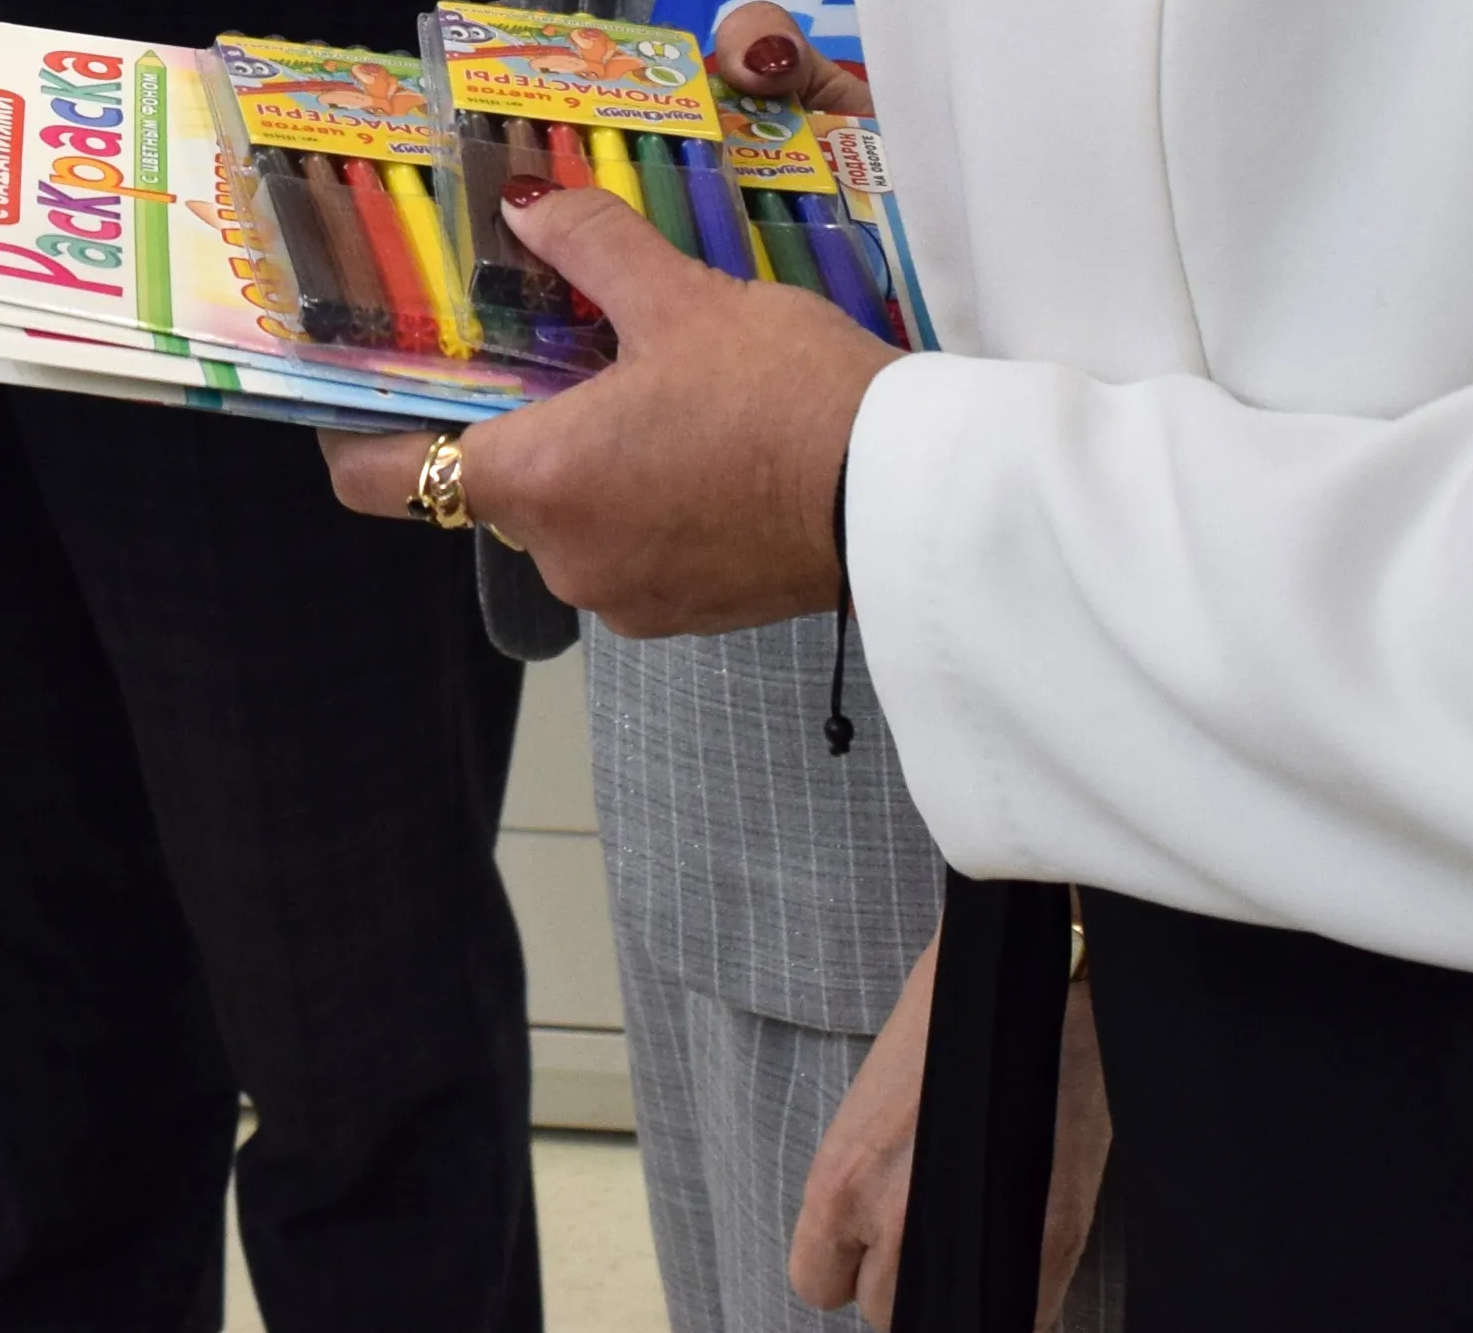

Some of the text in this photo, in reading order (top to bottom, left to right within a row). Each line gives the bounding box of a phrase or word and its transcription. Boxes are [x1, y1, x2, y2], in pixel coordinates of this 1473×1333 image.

[139, 72, 159, 114] ФОНОМ
[463, 67, 702, 111] ФЛОМАСТЕРЫ
[465, 83, 582, 110] 6 цветов
[254, 102, 430, 139] ОМАСТЕРЫ
[260, 119, 374, 145] 6 цветов
[139, 120, 160, 173] ЦВЕТНЫМ
[849, 130, 867, 188] ПОДАРОК
[868, 133, 887, 188] НА ОБОРОТЕ
